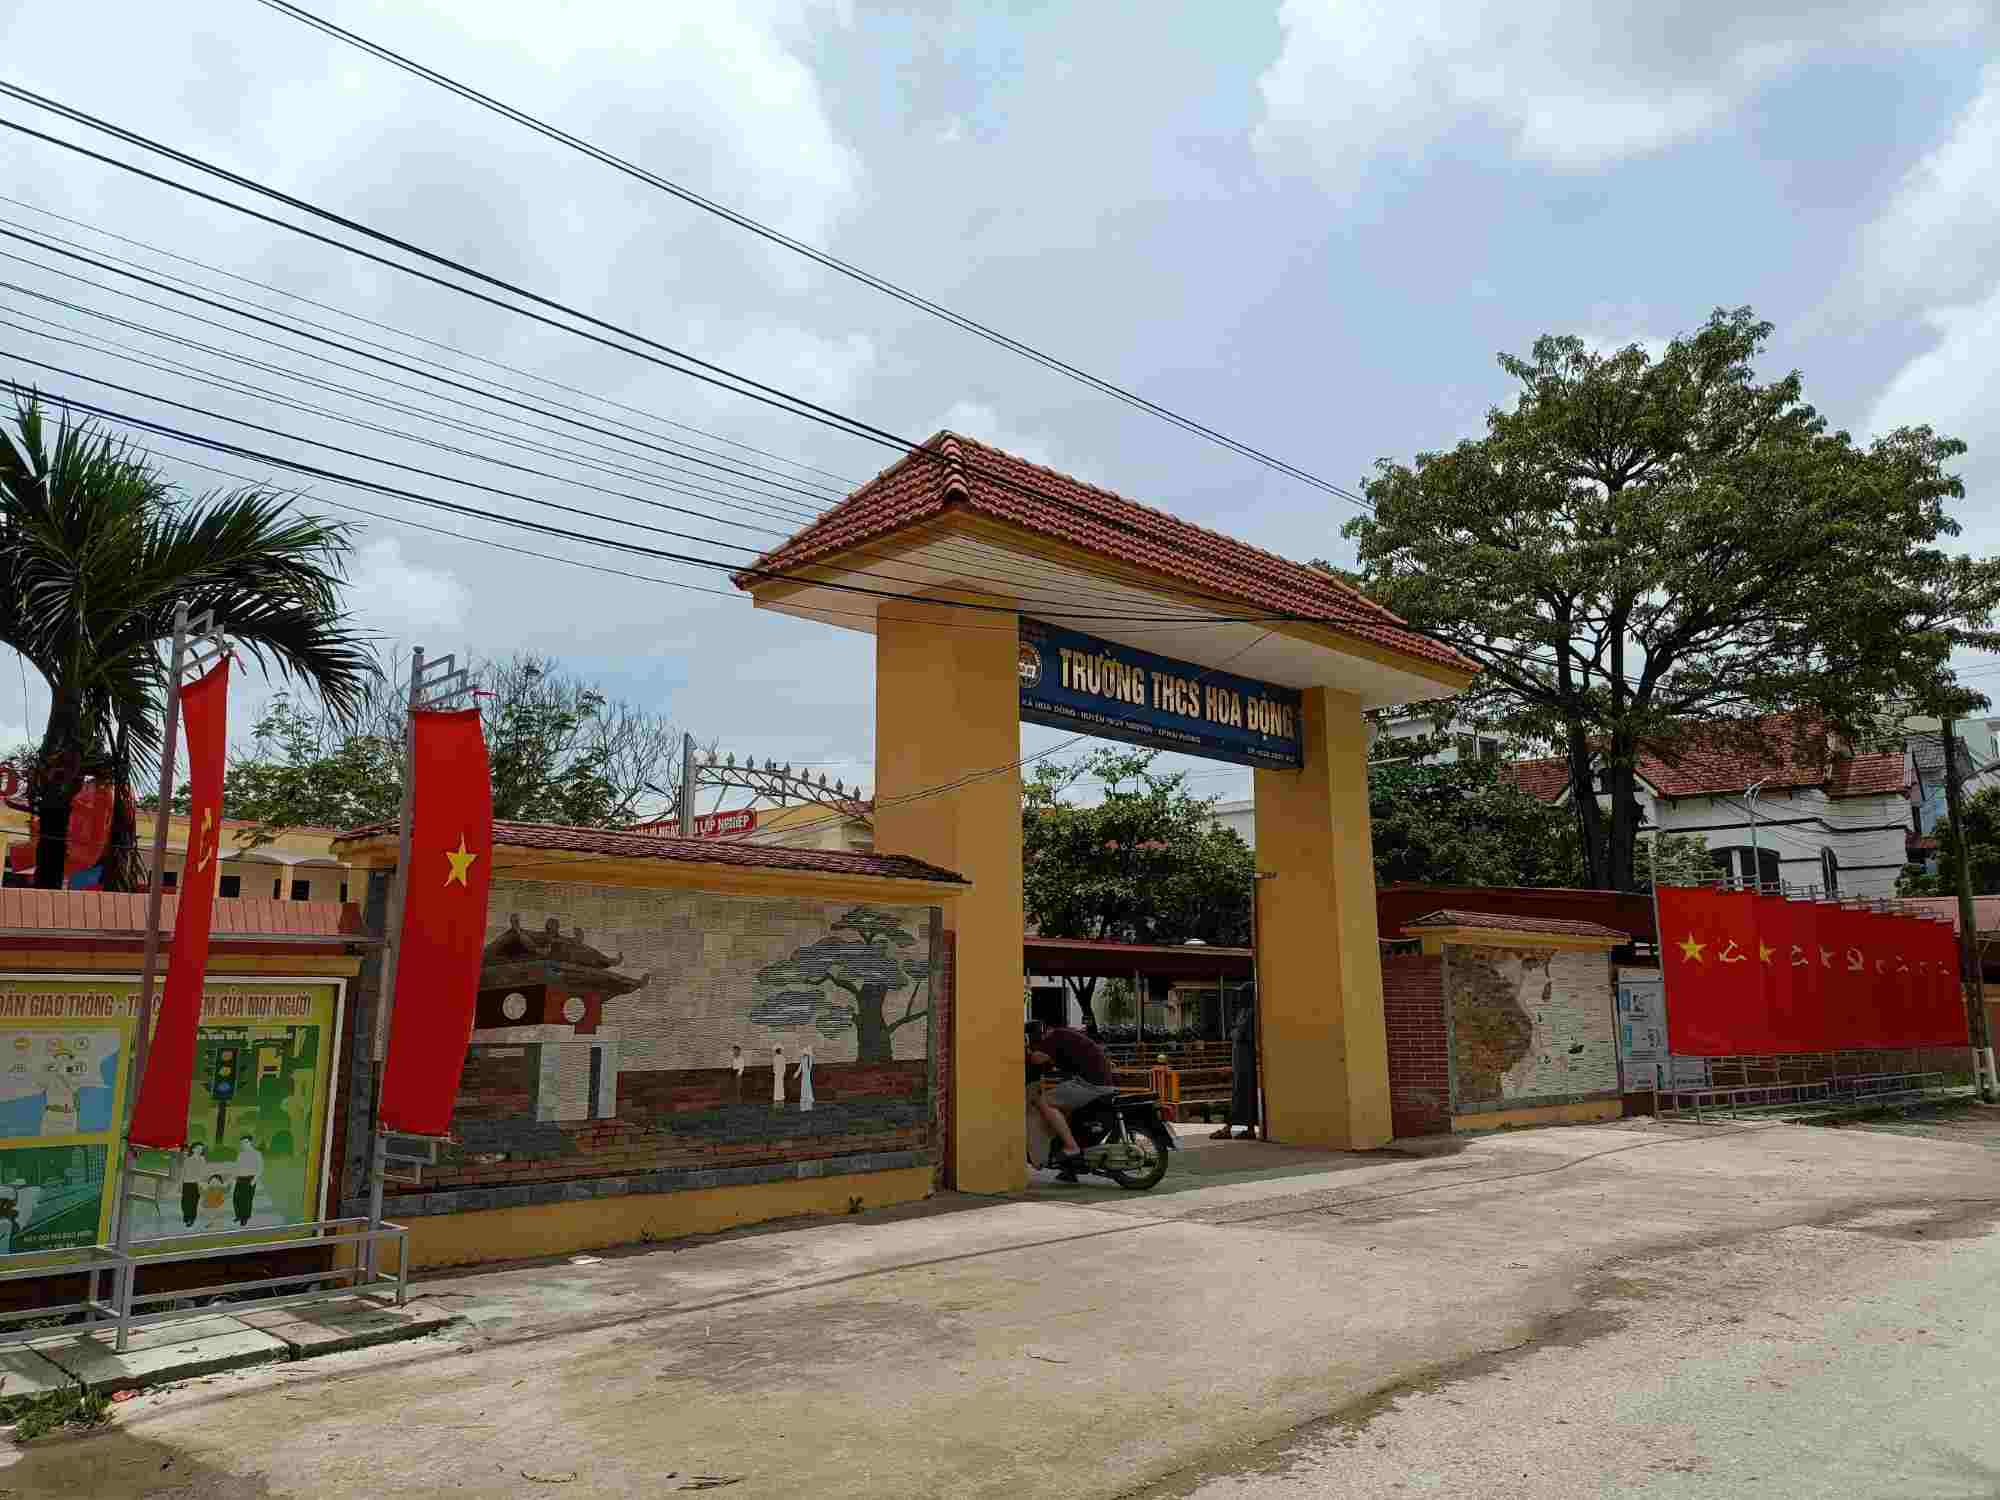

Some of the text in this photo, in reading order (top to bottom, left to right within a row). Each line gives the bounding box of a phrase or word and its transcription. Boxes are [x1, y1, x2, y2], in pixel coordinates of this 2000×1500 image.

[1057, 648, 1145, 705] TRƯỜNG
[1151, 671, 1201, 718] THCS
[1205, 686, 1242, 729] HOA
[30, 992, 65, 1016] GIAO
[67, 985, 114, 1016] THÔNG
